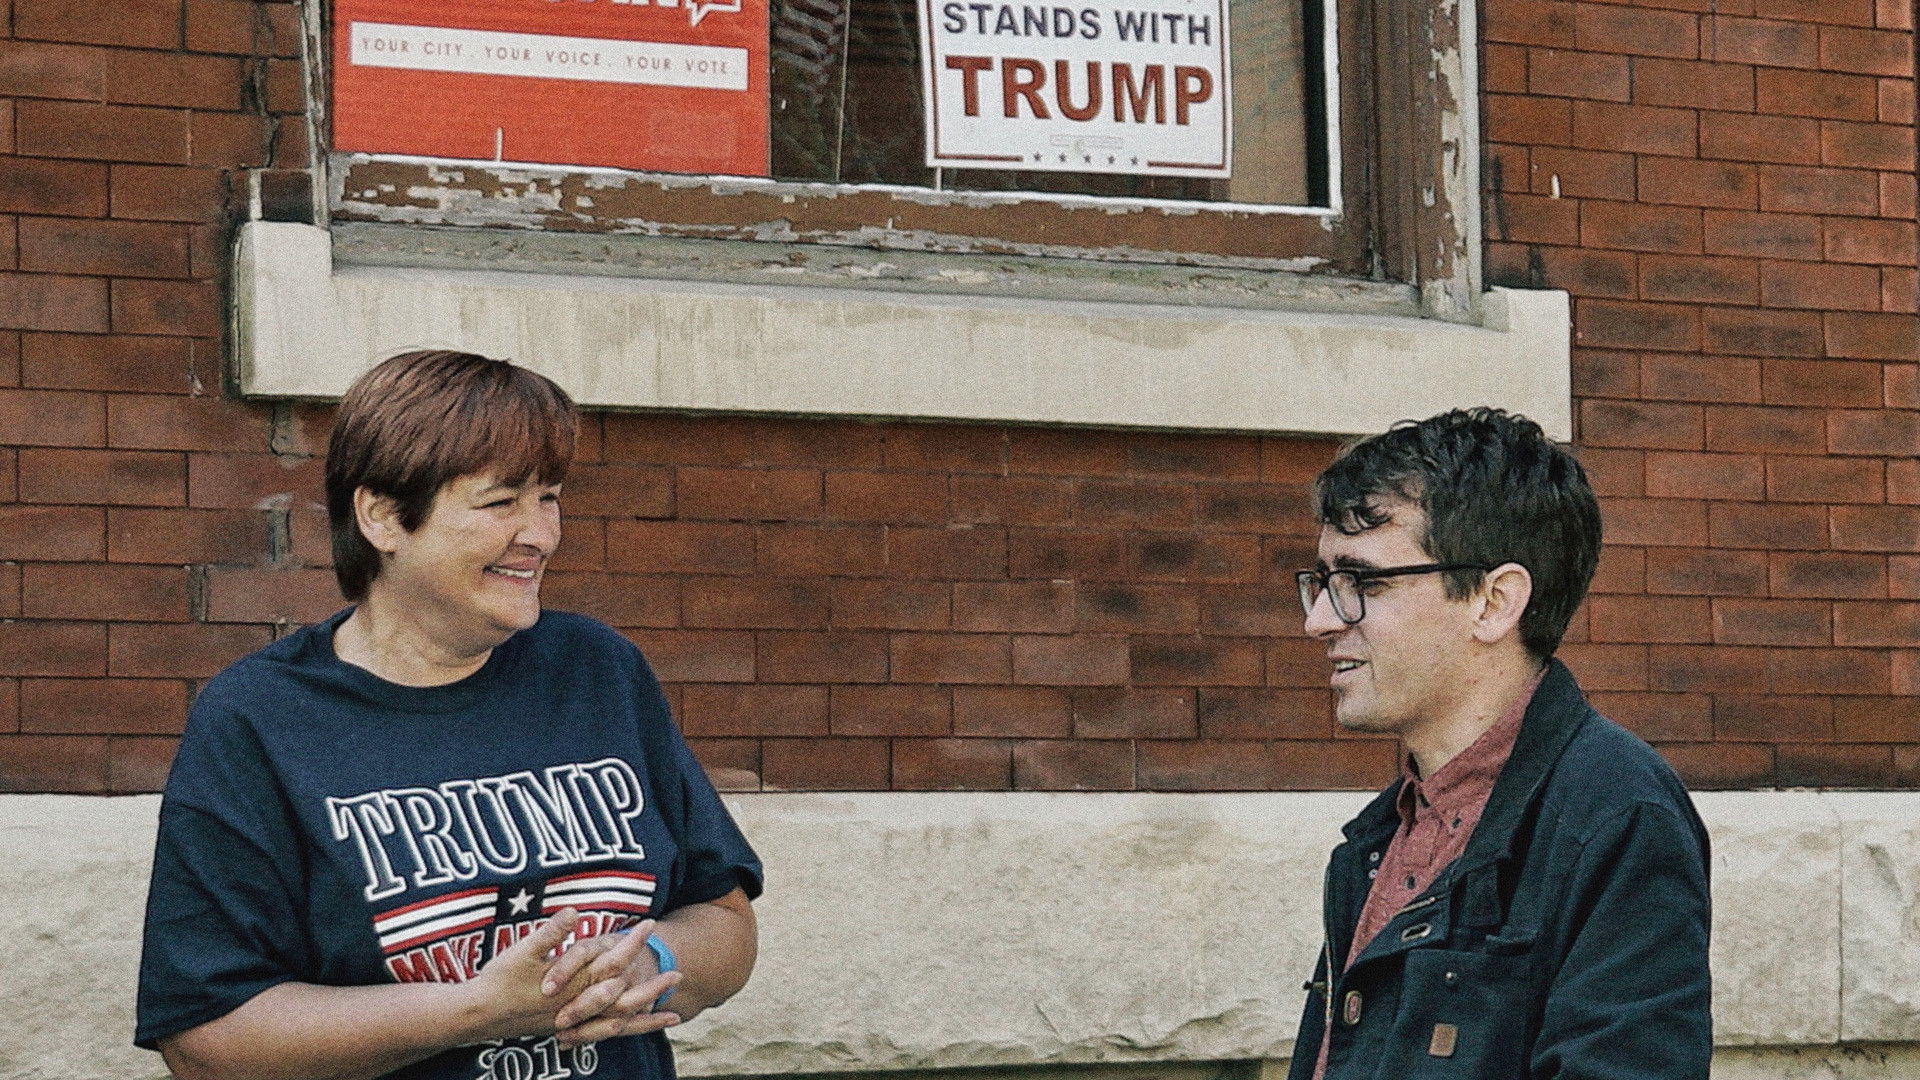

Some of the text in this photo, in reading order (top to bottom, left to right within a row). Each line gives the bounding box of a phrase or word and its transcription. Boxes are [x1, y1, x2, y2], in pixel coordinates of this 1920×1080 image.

[943, 2, 1212, 46] STANDS WITH
[362, 37, 410, 53] YOUR
[485, 45, 531, 61] YOUR
[626, 55, 672, 71] YOUR
[945, 55, 1214, 126] TRUMP
[326, 757, 646, 902] TRUMP
